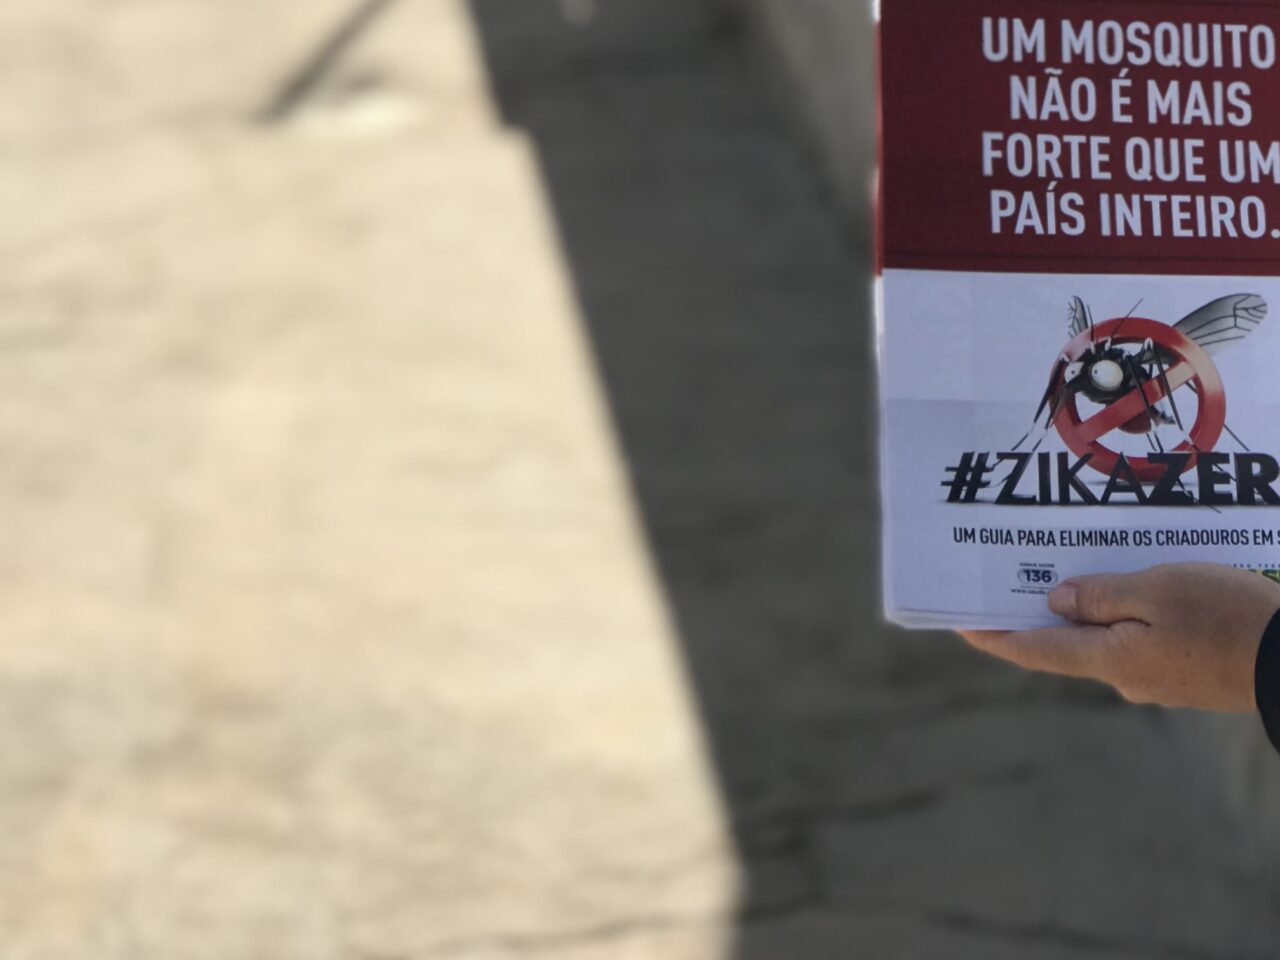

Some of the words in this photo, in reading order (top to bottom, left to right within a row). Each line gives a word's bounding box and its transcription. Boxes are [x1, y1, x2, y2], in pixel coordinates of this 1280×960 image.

[982, 17, 1046, 63] UM
[1060, 19, 1276, 69] MOSQUITO
[1010, 67, 1097, 121] NÃO
[1111, 68, 1133, 123] É
[1147, 79, 1252, 127] MAIS
[982, 131, 1112, 180] FORTE
[1125, 136, 1207, 182] QUE
[990, 181, 1086, 236] PAÍS
[953, 526, 976, 544] UM
[979, 527, 1015, 546] GUIA
[1017, 529, 1057, 547] PARA
[1059, 530, 1130, 548] ELIMINAR
[1132, 530, 1153, 547] OS
[1155, 529, 1250, 547] CRIADOUROS
[1252, 529, 1274, 546] EM
[1023, 569, 1052, 583] 136
